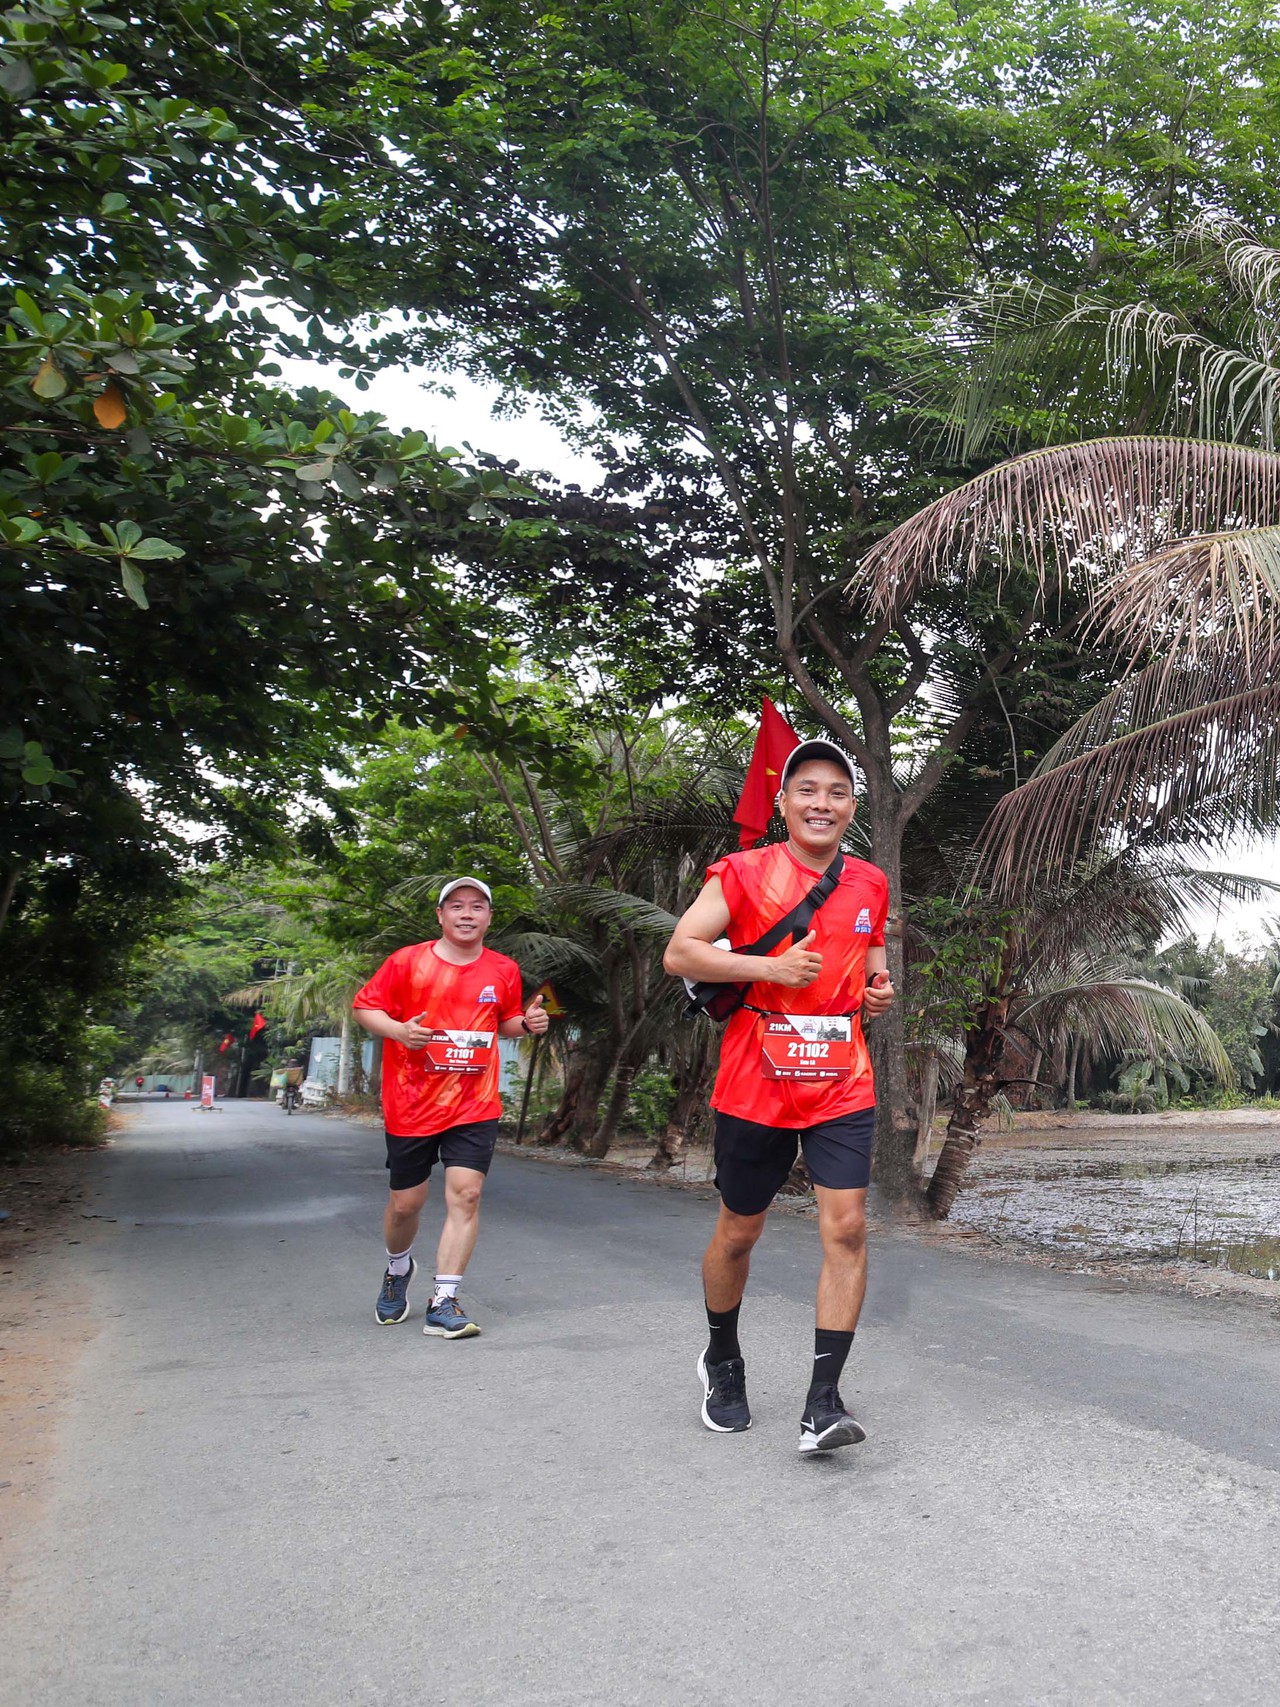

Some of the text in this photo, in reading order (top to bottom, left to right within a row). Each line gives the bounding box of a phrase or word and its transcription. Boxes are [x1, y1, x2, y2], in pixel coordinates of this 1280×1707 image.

[769, 1022, 792, 1032] 21KM
[445, 1047, 475, 1059] 21101
[787, 1042, 829, 1058] 21102
